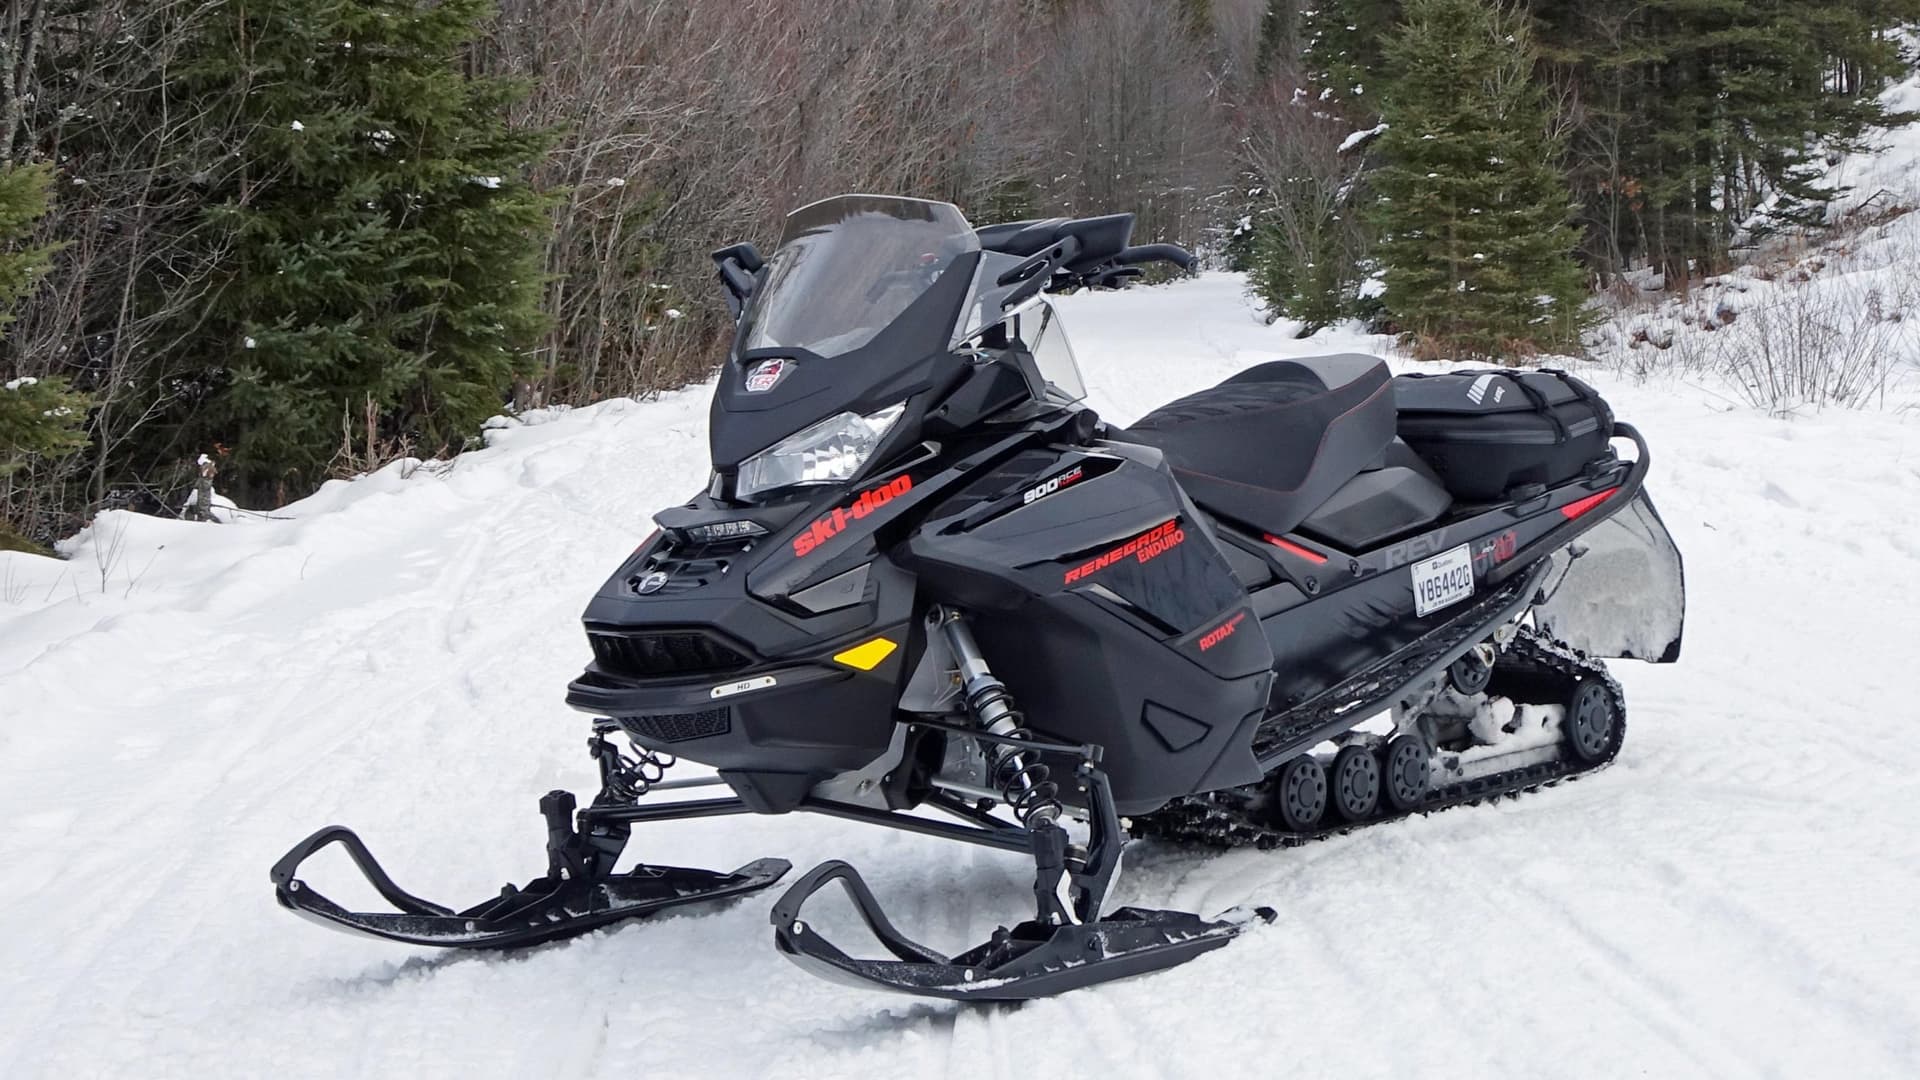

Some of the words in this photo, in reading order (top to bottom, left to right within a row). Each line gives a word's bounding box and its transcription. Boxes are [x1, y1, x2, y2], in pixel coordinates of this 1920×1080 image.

[1023, 477, 1059, 504] 900
[793, 474, 912, 557] ski-doo
[1064, 519, 1176, 585] RENEGADE
[1136, 529, 1185, 564] ENDURO
[1384, 527, 1448, 570] REV
[1199, 621, 1235, 651] ROTAX
[736, 682, 751, 691] HD
